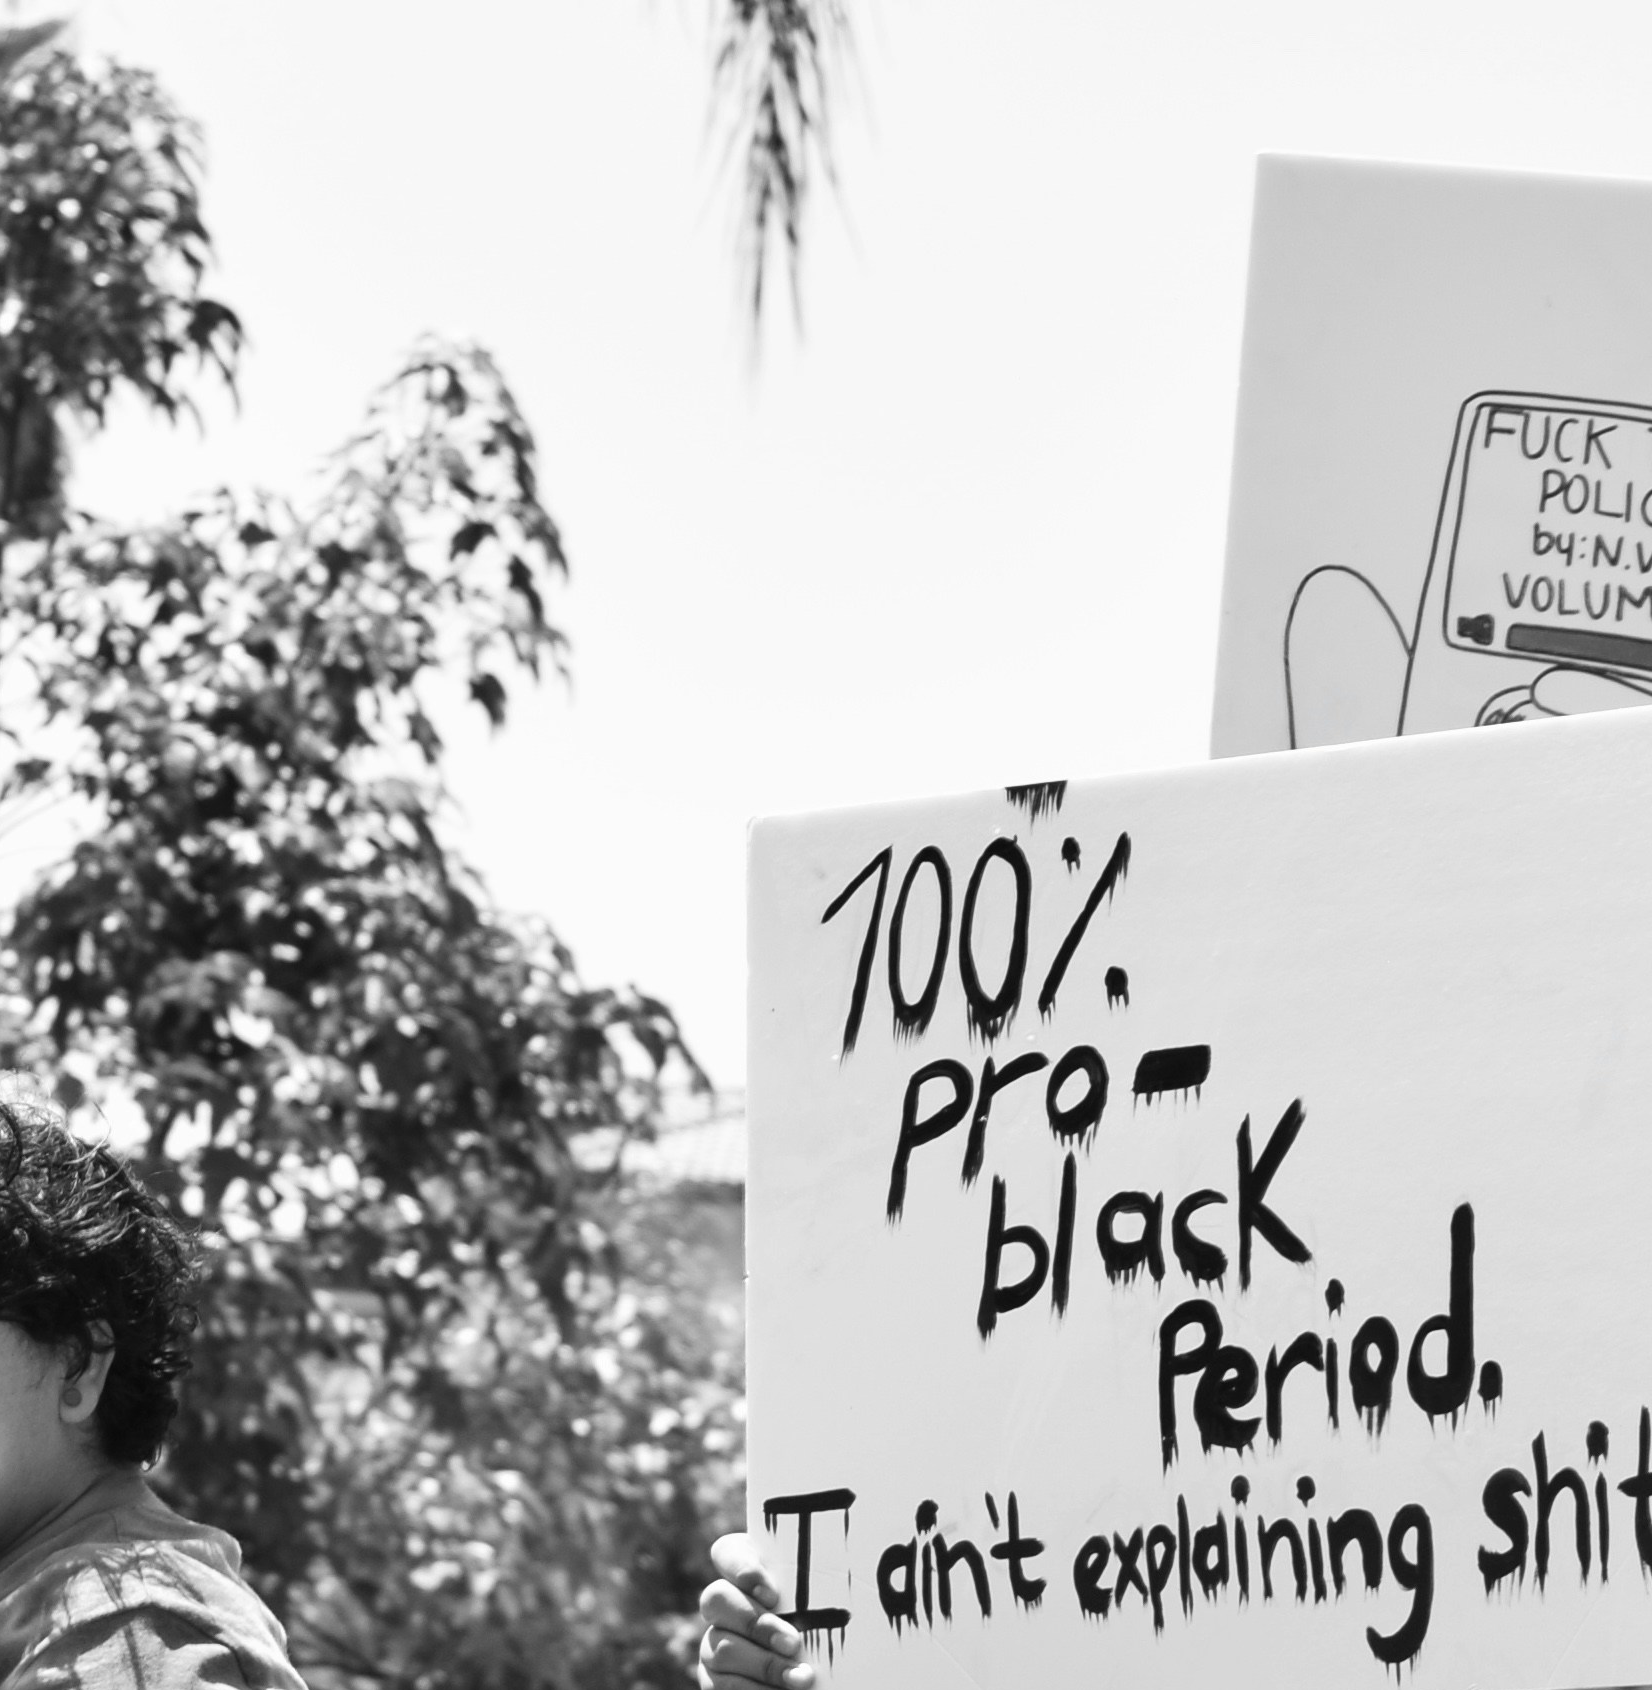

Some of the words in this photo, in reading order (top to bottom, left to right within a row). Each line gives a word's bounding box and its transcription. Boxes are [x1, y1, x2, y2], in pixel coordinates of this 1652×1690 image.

[1483, 407, 1618, 470] FUCK
[821, 832, 1131, 1062] 100%
[887, 1043, 1212, 1225] pro-
[763, 1487, 856, 1662] I
[877, 1493, 1046, 1634] ain't
[1073, 1475, 1434, 1682] explaining
